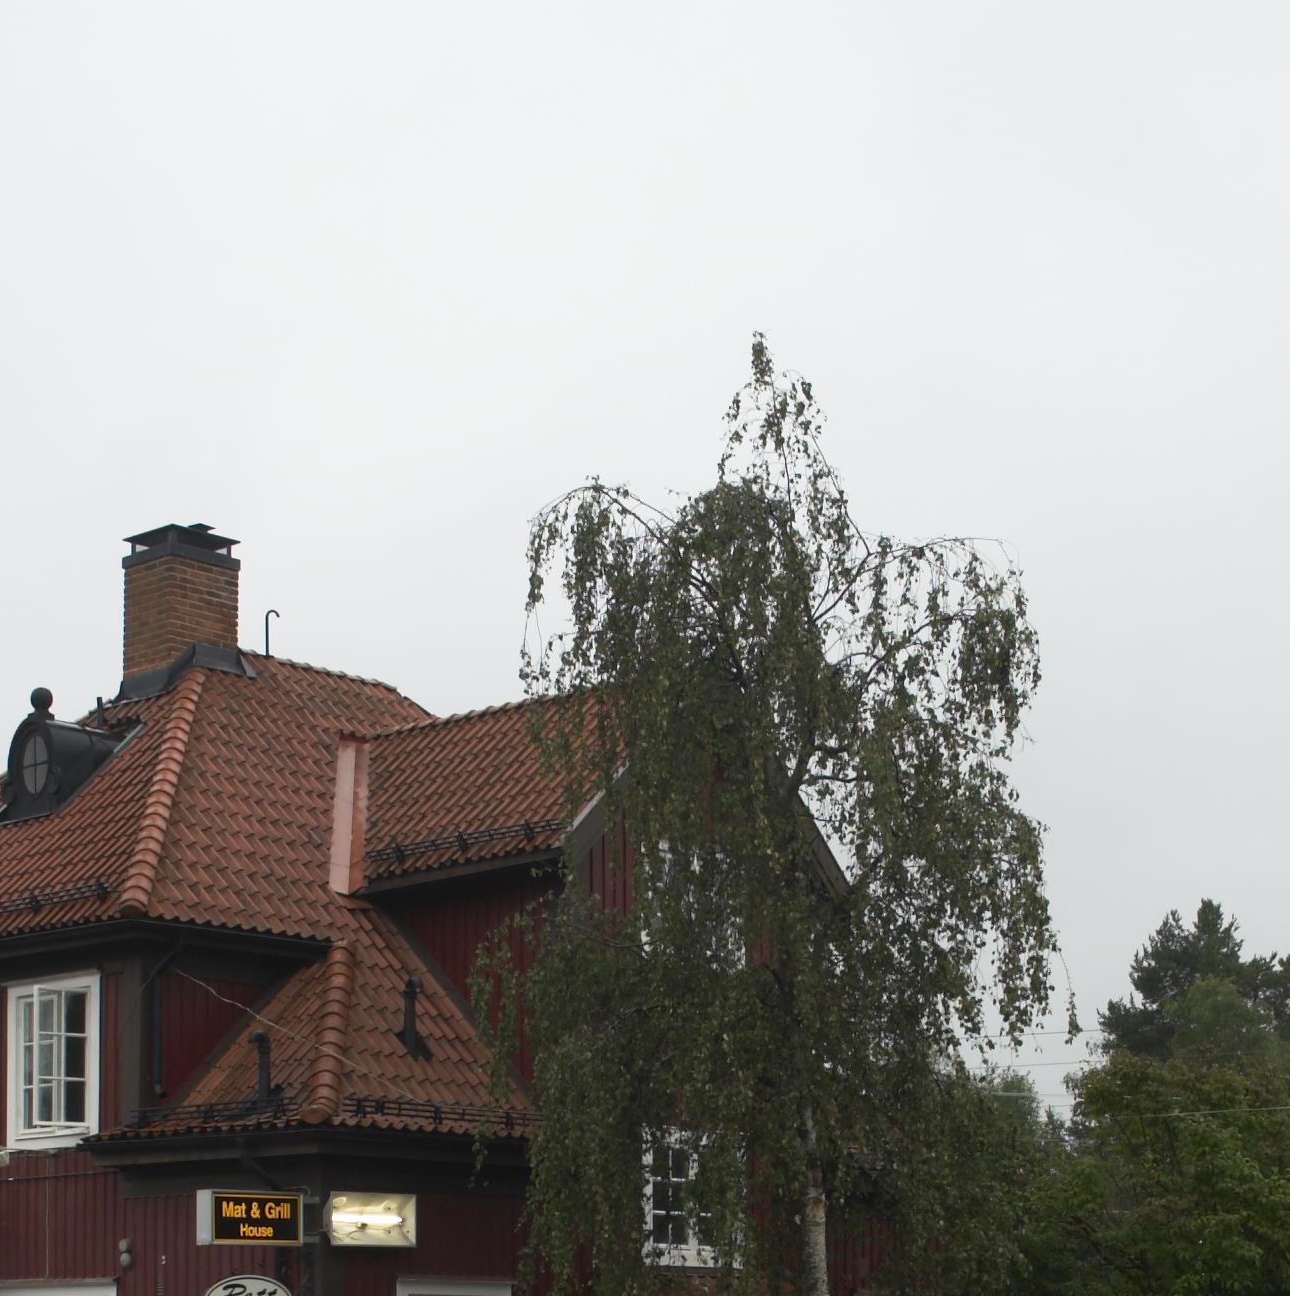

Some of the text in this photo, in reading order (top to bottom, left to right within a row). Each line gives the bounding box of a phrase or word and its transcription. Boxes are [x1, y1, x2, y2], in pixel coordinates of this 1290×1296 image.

[222, 1201, 291, 1219] Mat & Grill
[240, 1223, 273, 1237] House
